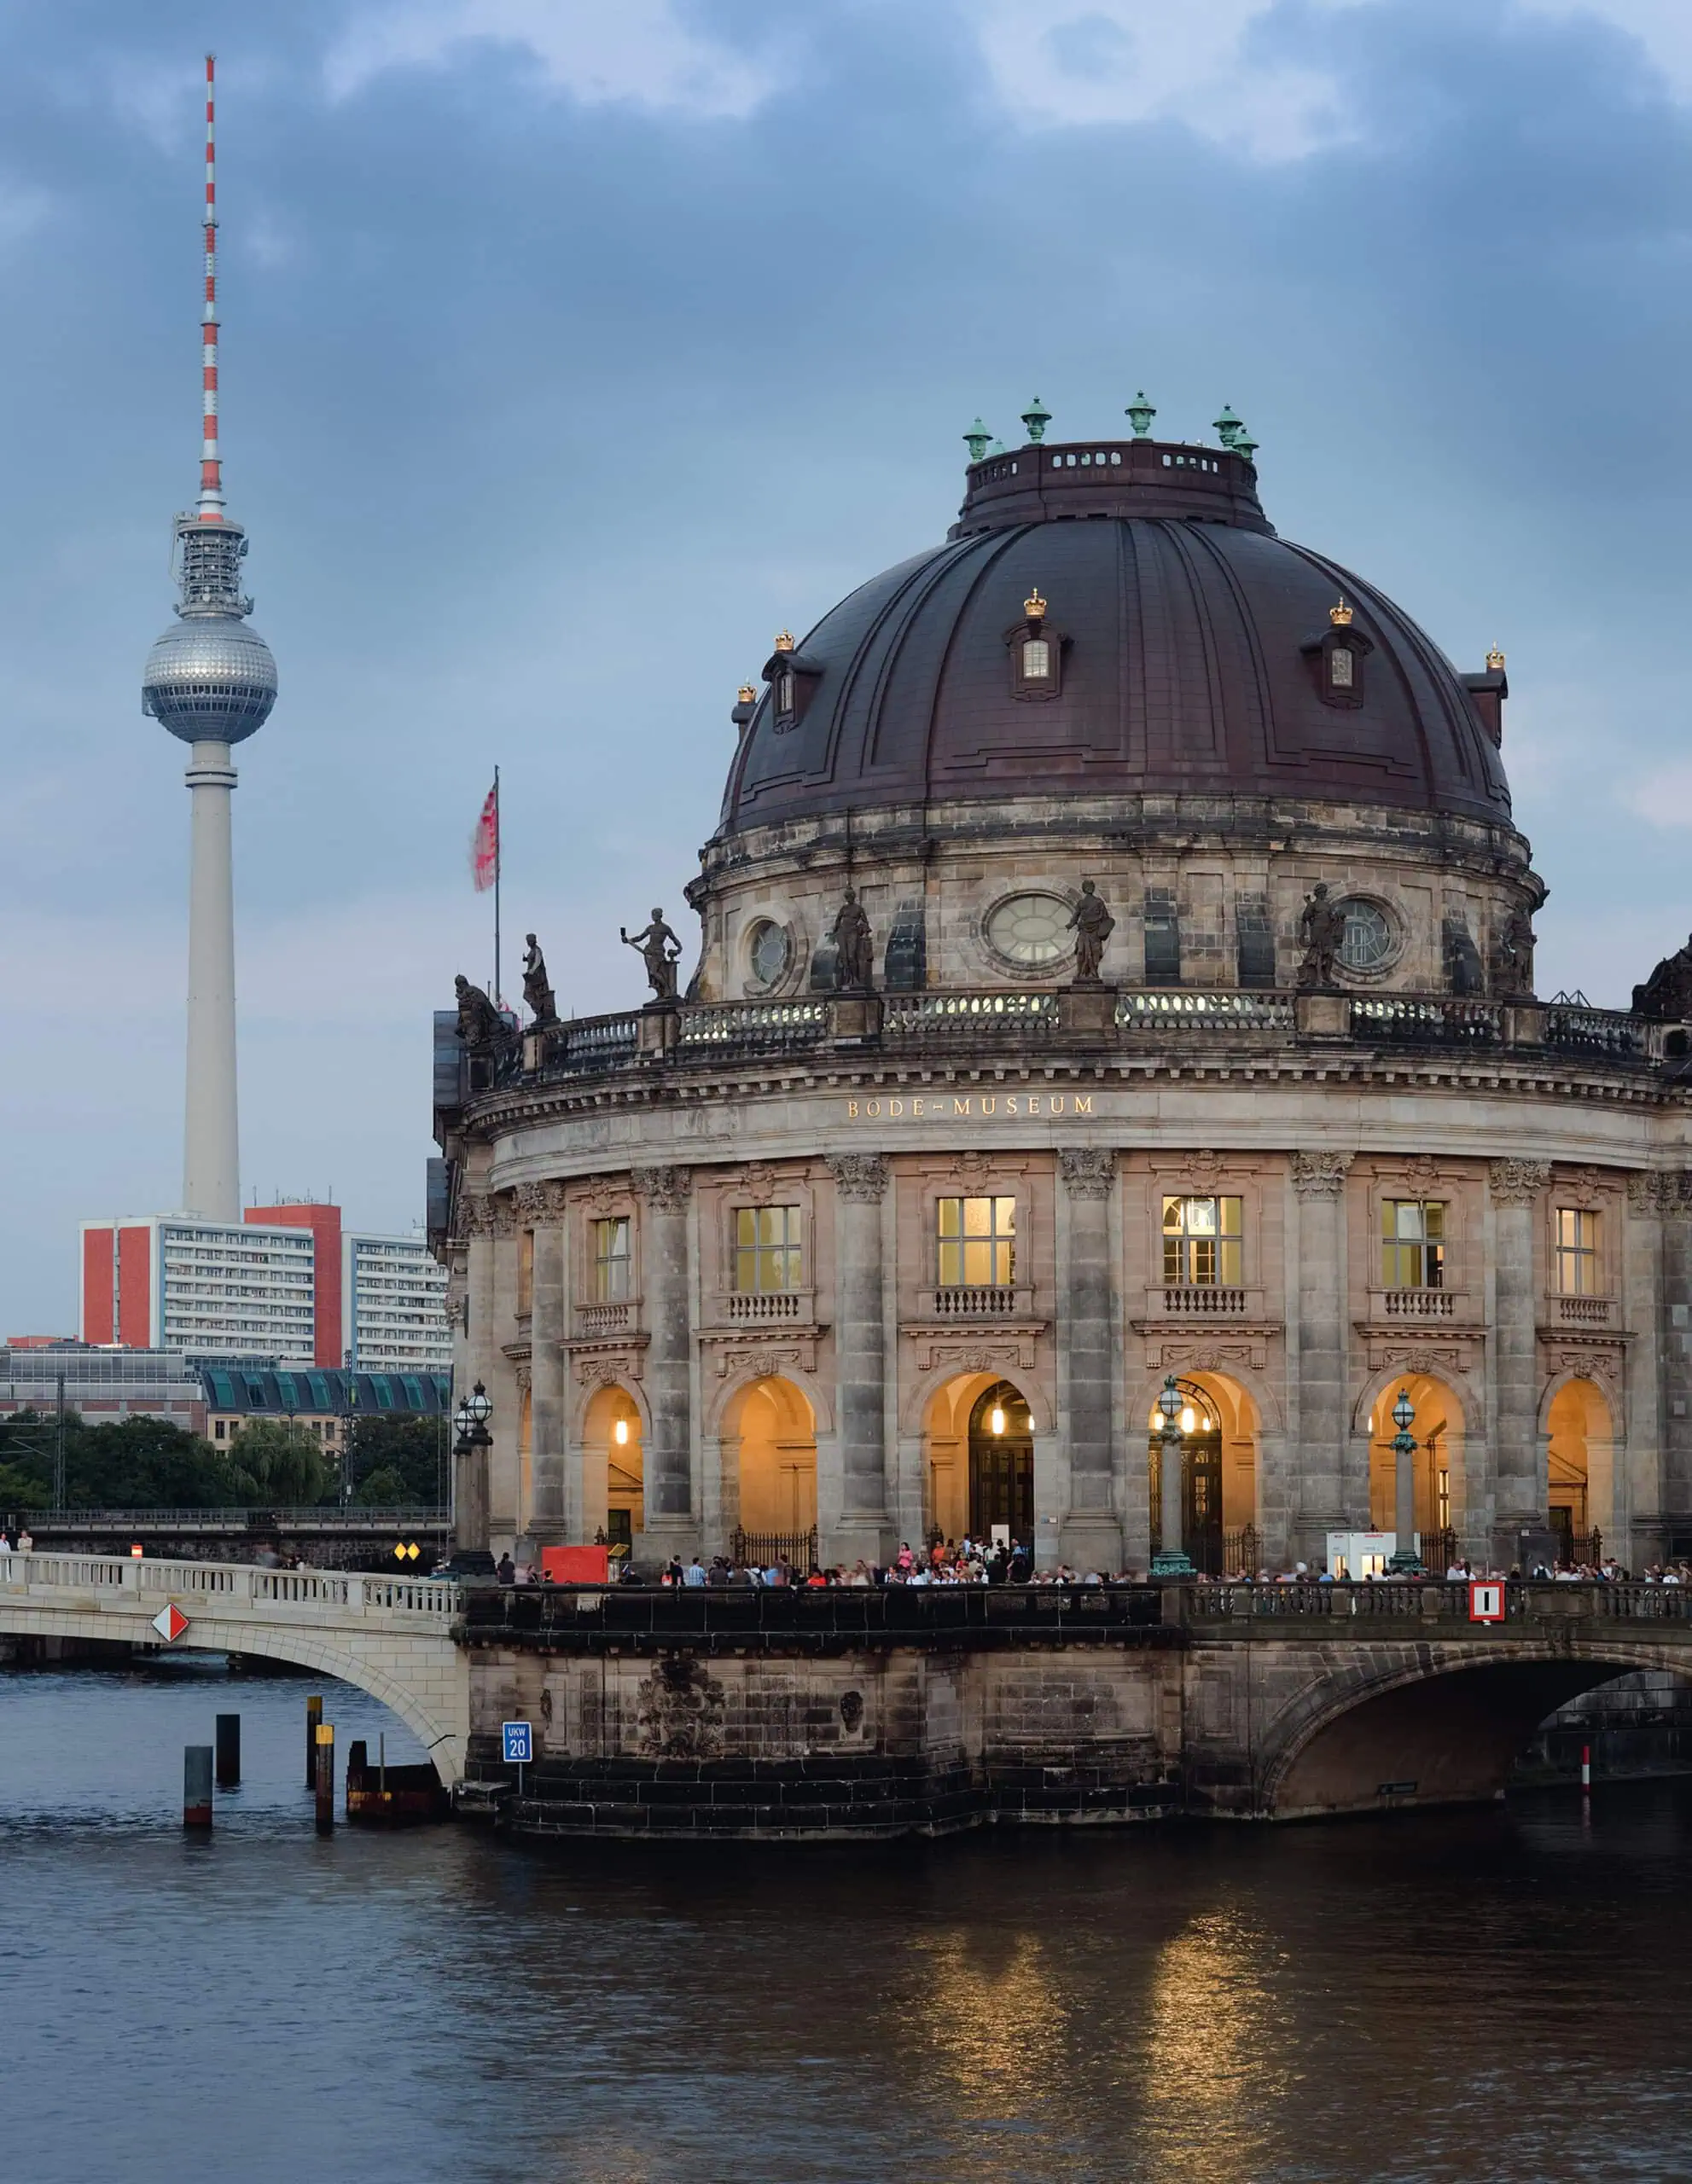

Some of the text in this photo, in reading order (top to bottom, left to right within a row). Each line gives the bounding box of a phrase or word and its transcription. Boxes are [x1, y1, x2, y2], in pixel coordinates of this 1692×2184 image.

[848, 1096, 1093, 1118] BODE-MUSEUM
[508, 1727, 526, 1737] UKW
[509, 1740, 526, 1757] 20
